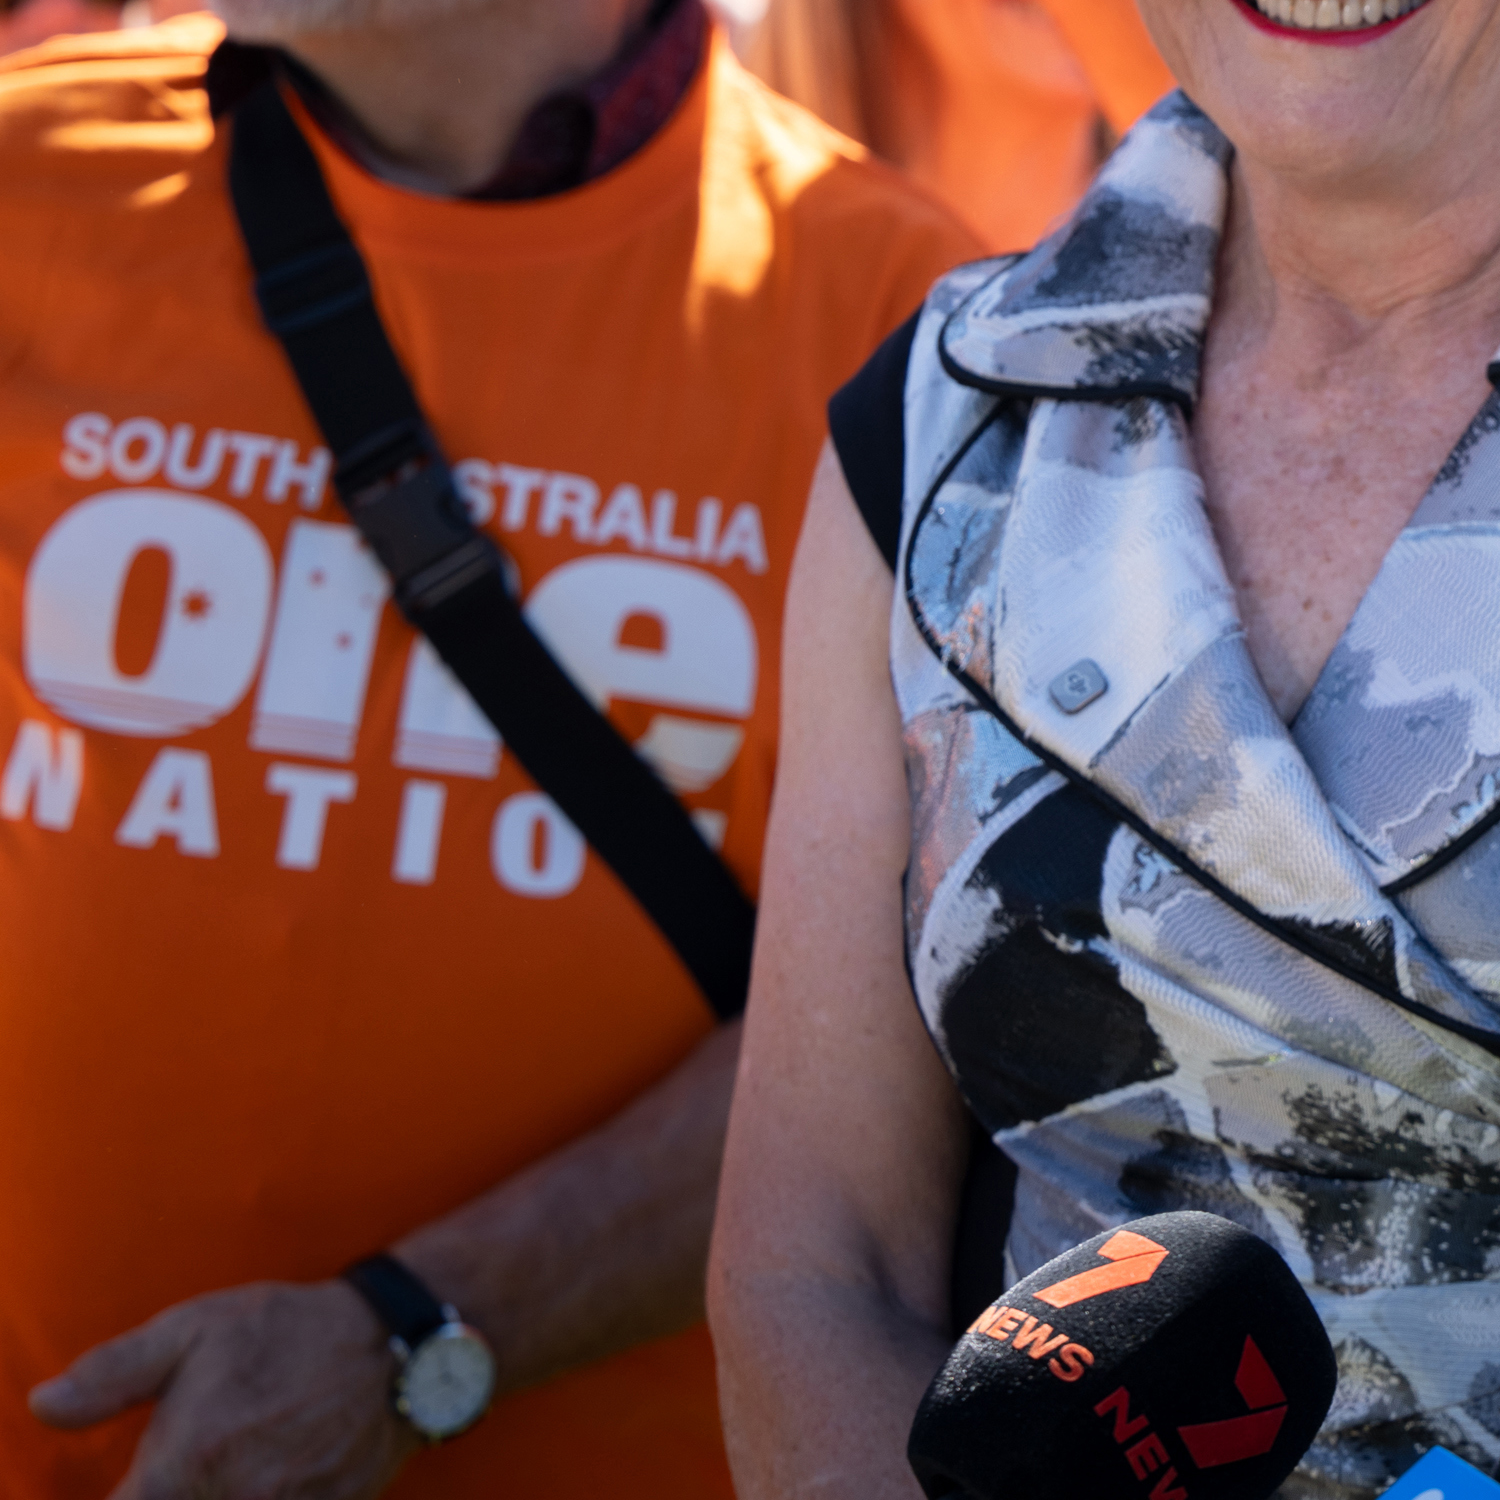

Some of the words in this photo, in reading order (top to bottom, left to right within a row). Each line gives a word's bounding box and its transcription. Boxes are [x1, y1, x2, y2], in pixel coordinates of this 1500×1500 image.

[61, 412, 333, 511] SOUTH
[455, 459, 771, 574] STRALIA
[0, 719, 728, 899] NATIO
[967, 1305, 1095, 1382] NEWS
